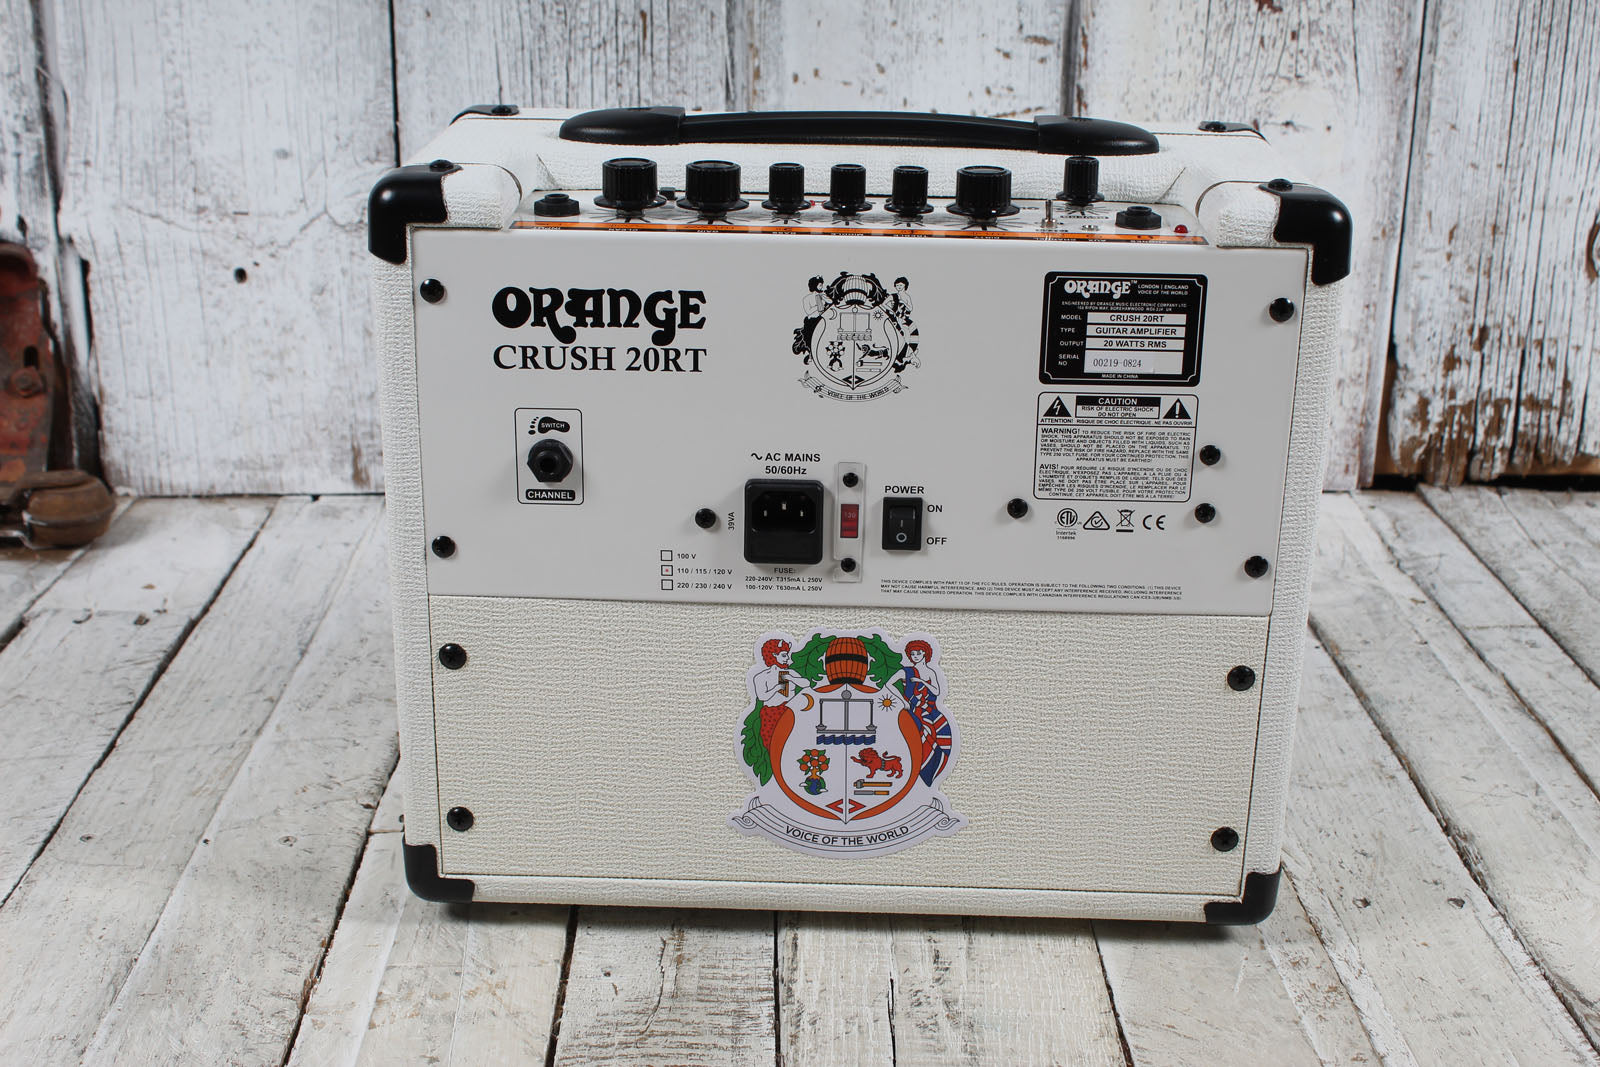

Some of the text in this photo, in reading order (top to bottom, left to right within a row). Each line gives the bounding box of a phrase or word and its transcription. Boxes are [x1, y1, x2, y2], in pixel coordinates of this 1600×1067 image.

[492, 287, 706, 346] ORANGE
[1109, 314, 1141, 322] CRUSH
[1095, 327, 1128, 335] GUITAR
[1130, 328, 1177, 336] AMPLIFIER
[1115, 340, 1145, 348] WATTS
[493, 344, 707, 373] CRUSH 20RT
[827, 390, 844, 399] VOICE
[868, 387, 890, 399] WORLD
[1098, 397, 1138, 406] CAUTION
[764, 453, 821, 462] AC MAINS
[765, 465, 807, 475] 50/60Hz
[884, 485, 925, 494] POWER
[527, 491, 573, 500] CHANNEL
[927, 504, 943, 513] ON
[926, 537, 948, 545] OFF
[785, 825, 910, 846] VOICE OF THE WORLD
